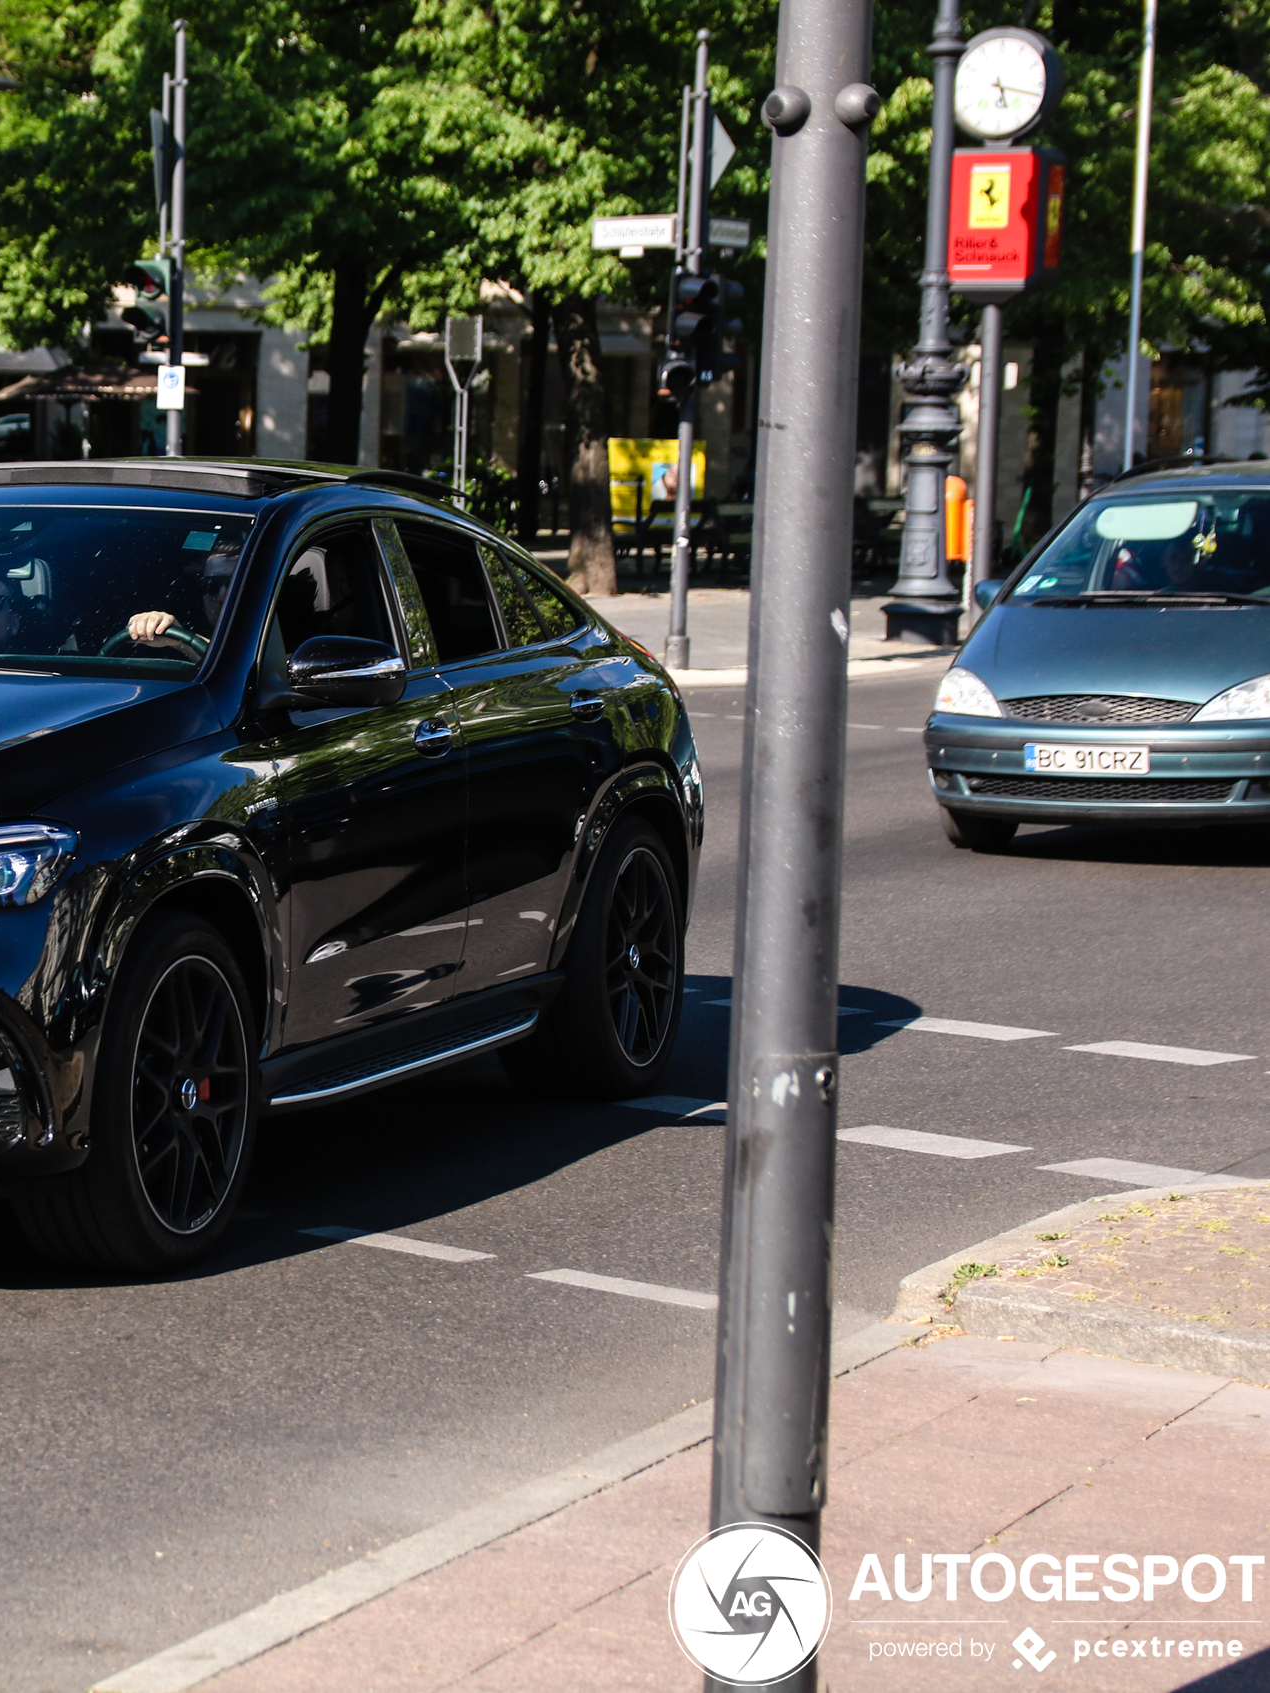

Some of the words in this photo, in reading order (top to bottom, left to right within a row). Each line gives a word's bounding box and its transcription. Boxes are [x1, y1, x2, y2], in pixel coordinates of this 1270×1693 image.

[955, 249, 1020, 261] Schnauck
[1038, 749, 1066, 768] BC
[1075, 750, 1143, 771] 91CRZ
